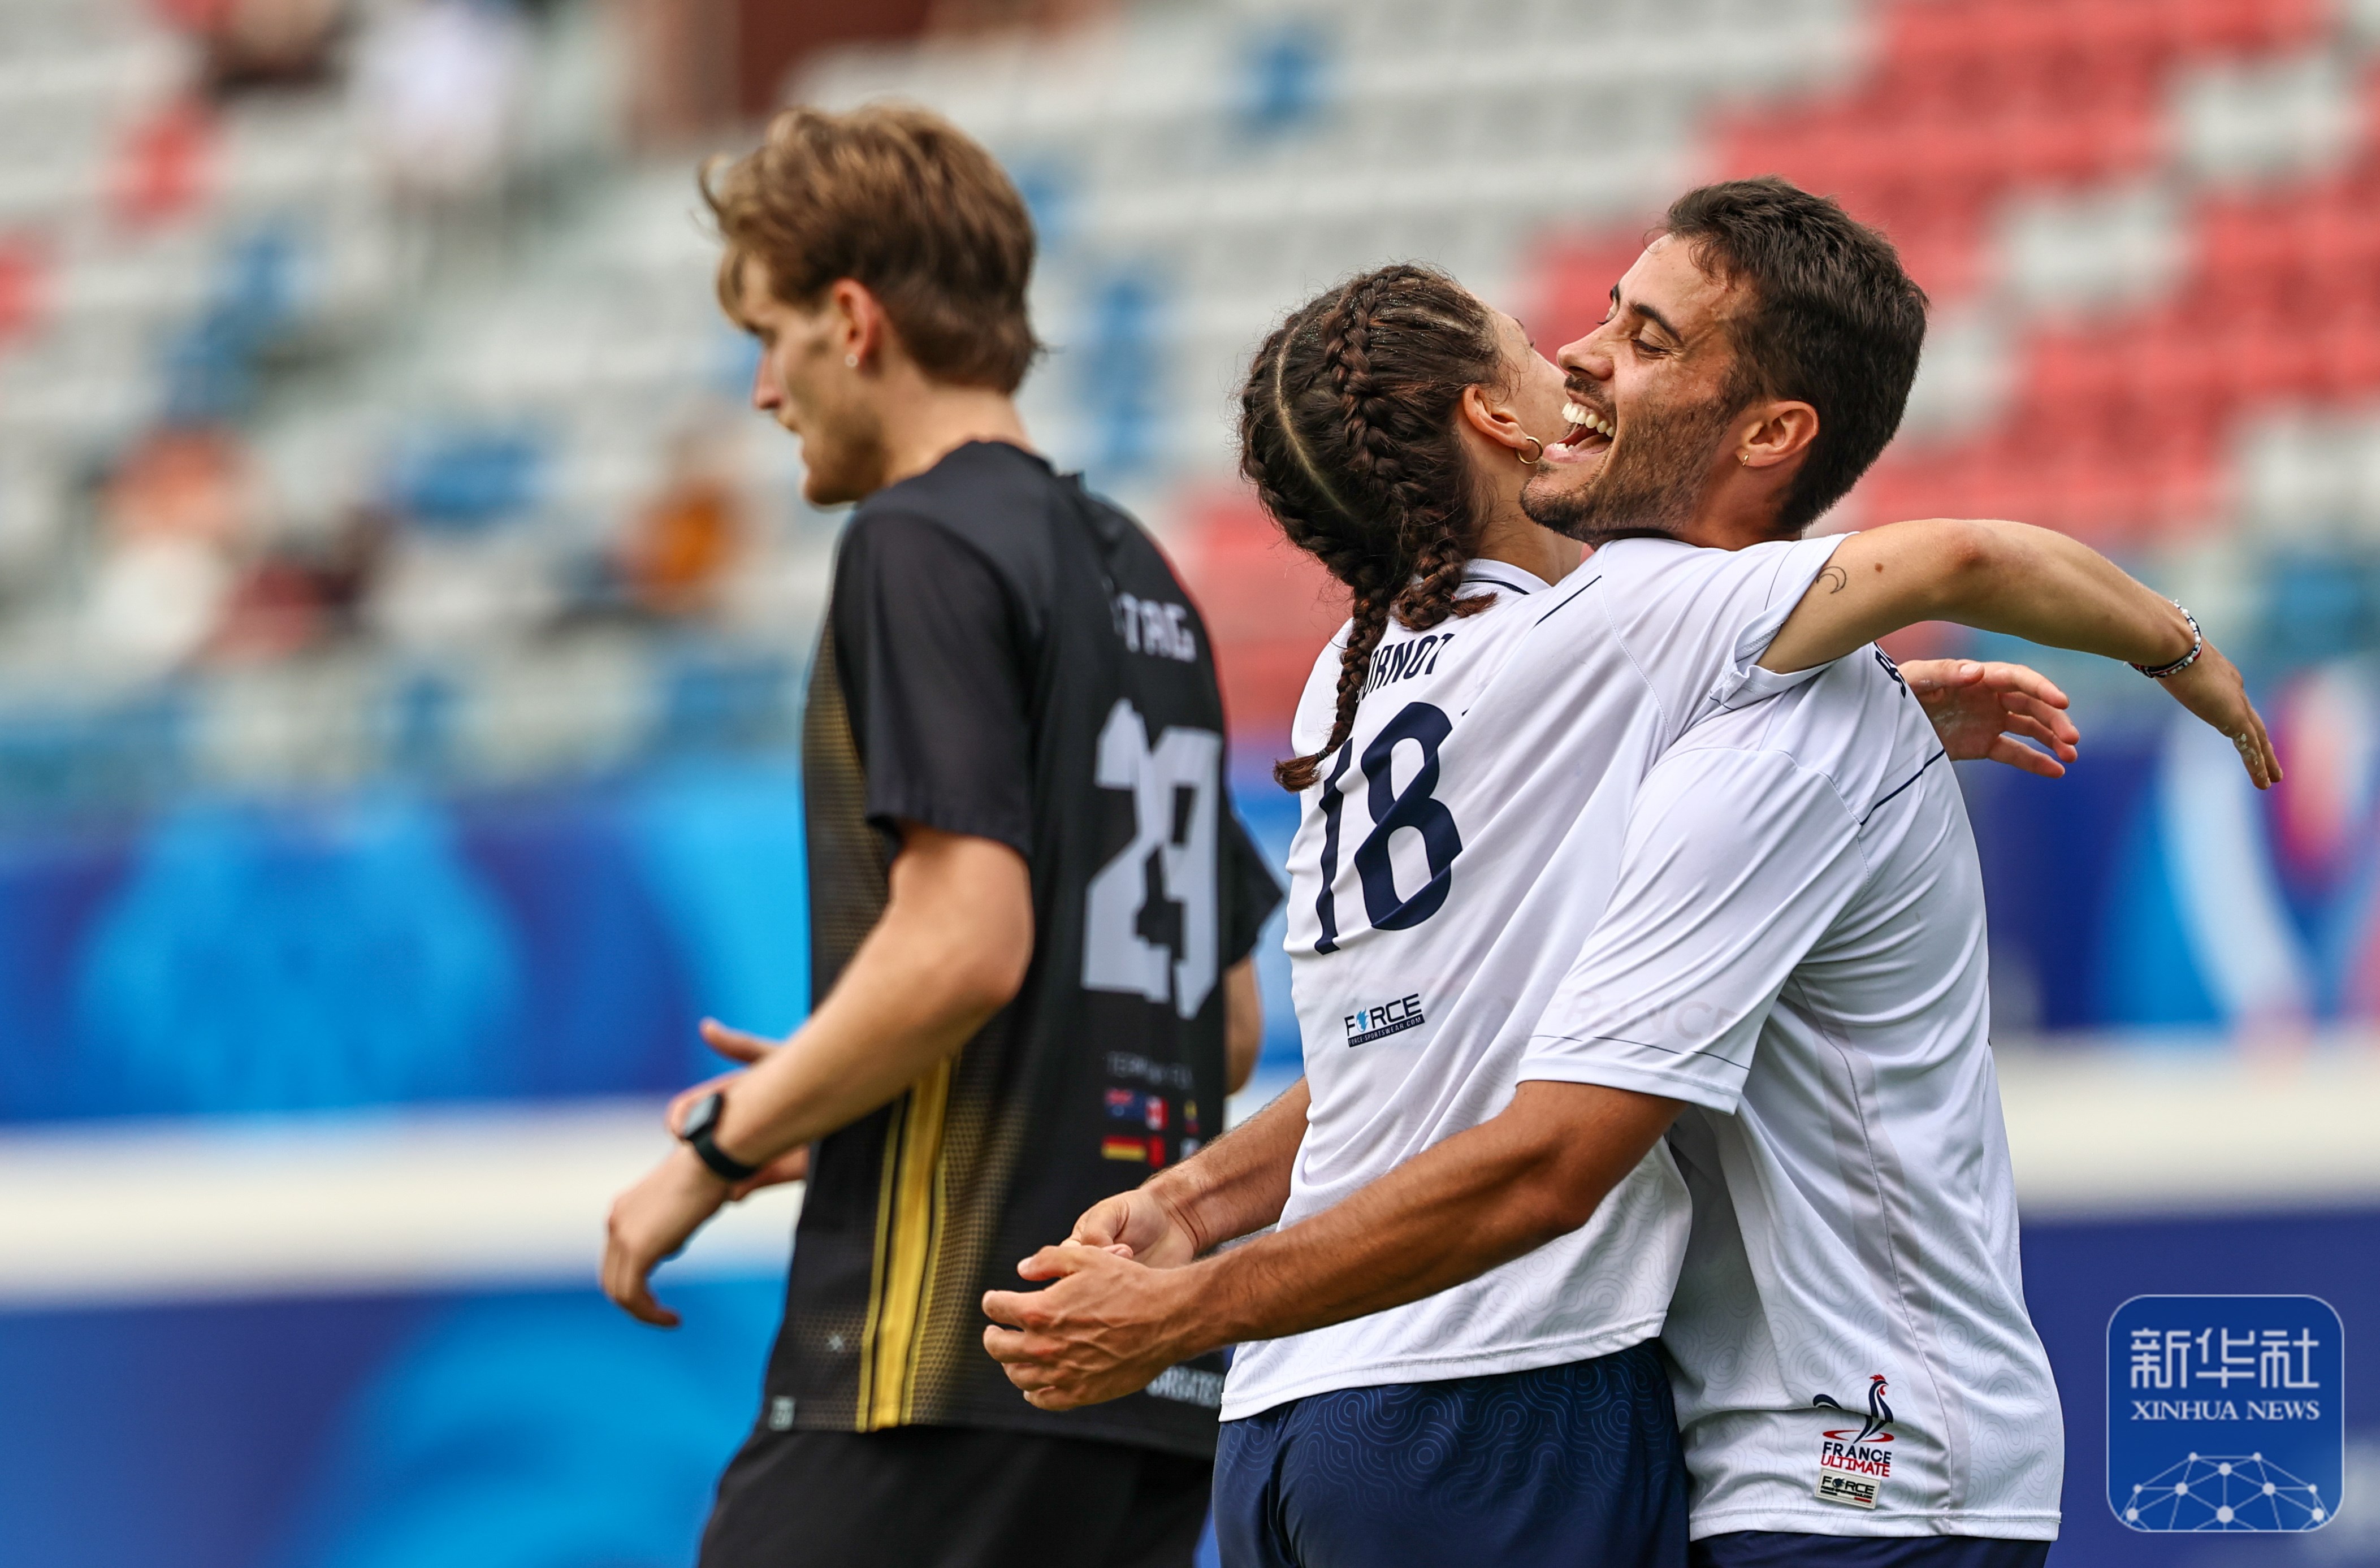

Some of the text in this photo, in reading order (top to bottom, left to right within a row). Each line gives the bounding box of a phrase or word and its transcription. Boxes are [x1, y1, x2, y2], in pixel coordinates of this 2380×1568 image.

[1360, 633, 1455, 700] ORNOT
[1314, 701, 1462, 955] 18
[1081, 698, 1222, 1019] 29
[1344, 993, 1422, 1037] FORCE
[1820, 1454, 1890, 1477] ULTIMATE
[1823, 1441, 1892, 1465] FRANCE
[1822, 1475, 1875, 1495] FORCE
